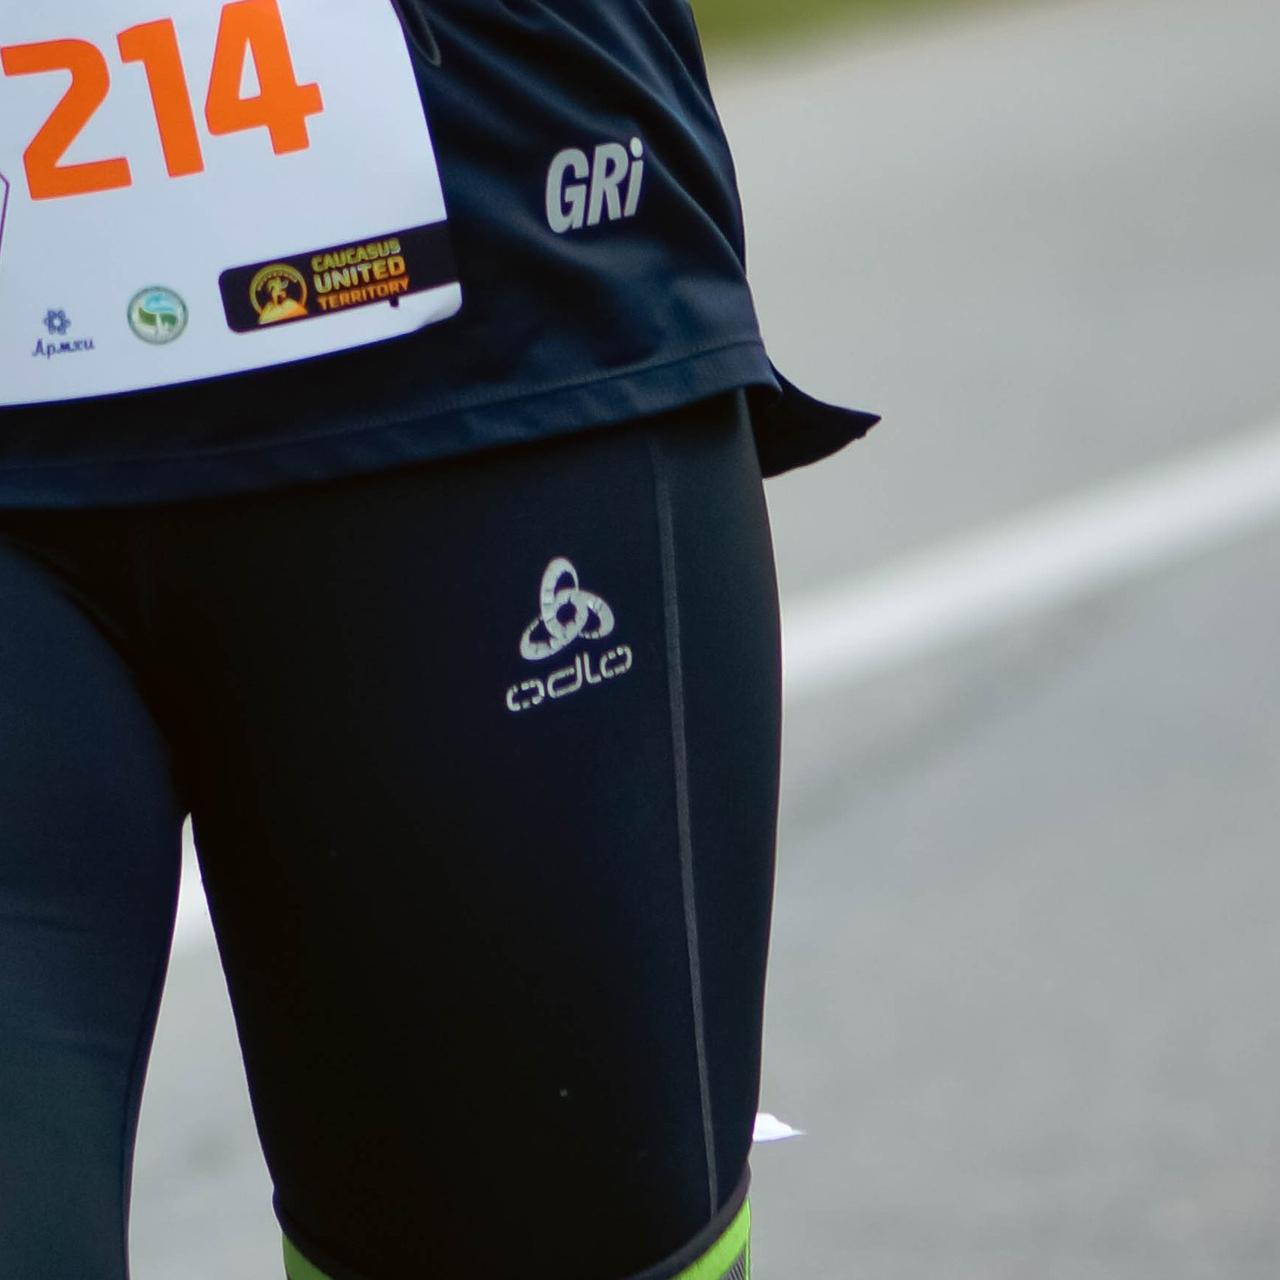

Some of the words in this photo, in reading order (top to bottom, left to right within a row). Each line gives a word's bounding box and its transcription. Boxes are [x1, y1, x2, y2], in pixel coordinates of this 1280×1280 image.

[311, 237, 401, 272] CAUCASUS
[314, 256, 406, 294] UNITED
[318, 275, 410, 311] TERRITORY
[505, 643, 633, 712] odlo
